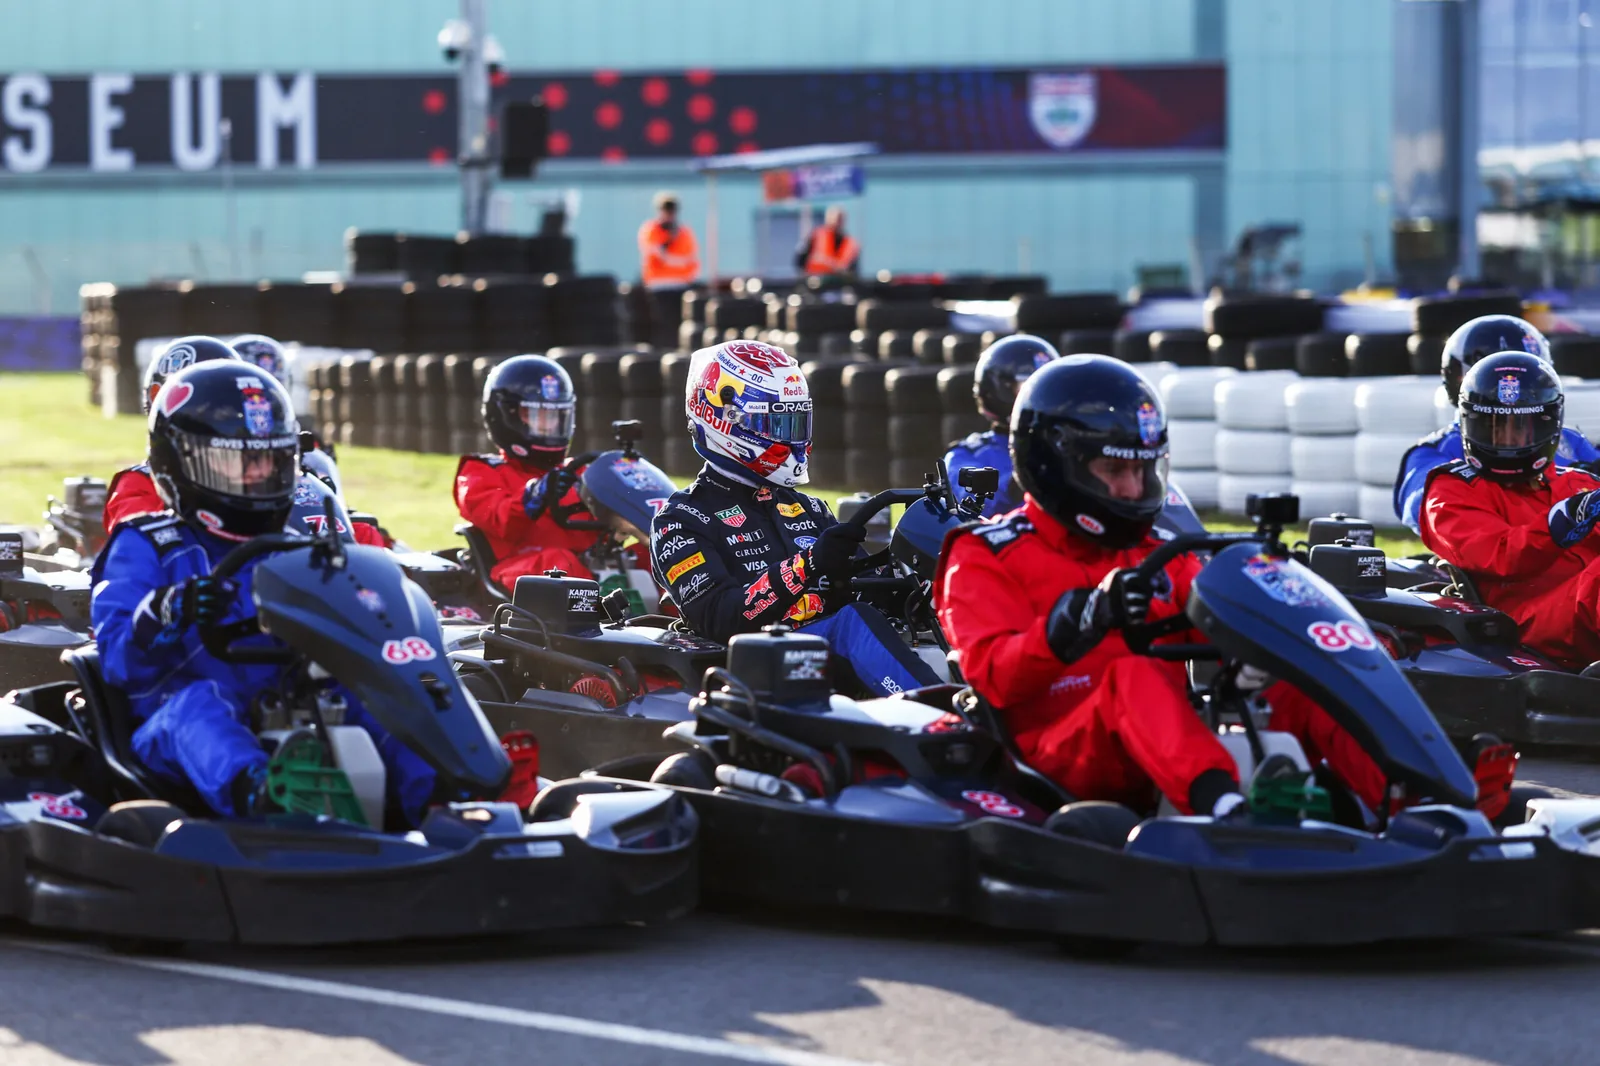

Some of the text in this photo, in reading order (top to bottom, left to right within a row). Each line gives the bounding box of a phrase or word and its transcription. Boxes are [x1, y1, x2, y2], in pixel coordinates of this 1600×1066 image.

[2, 71, 317, 172] SEUM
[1473, 404, 1492, 413] GIVES
[211, 437, 244, 449] GIVES
[247, 438, 270, 450] YOU
[1103, 445, 1135, 459] GIVES
[676, 503, 710, 524] sparco
[719, 507, 741, 519] TAG
[726, 533, 752, 545] Mobil
[659, 537, 696, 562] TRADE
[669, 555, 702, 581] PIRELLI
[743, 560, 768, 572] VISA
[569, 588, 598, 597] KARTING
[1307, 620, 1377, 652] 80
[382, 637, 437, 665] 68
